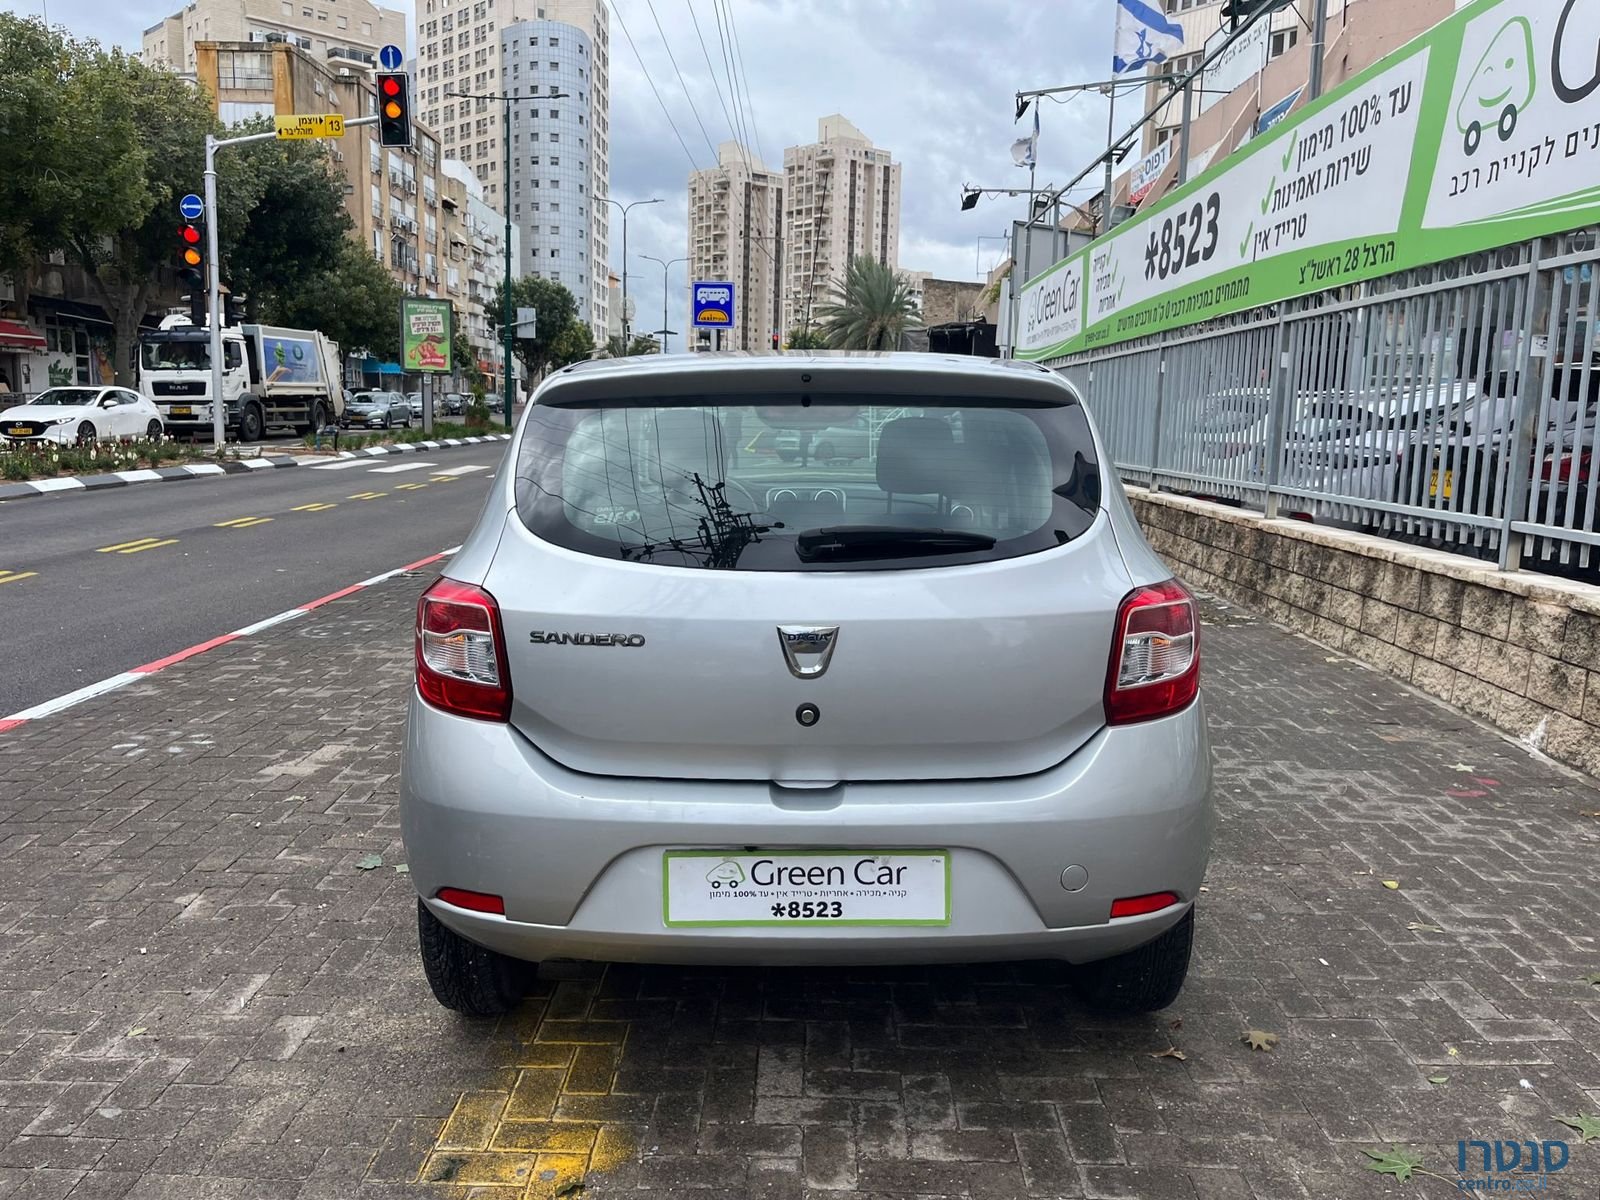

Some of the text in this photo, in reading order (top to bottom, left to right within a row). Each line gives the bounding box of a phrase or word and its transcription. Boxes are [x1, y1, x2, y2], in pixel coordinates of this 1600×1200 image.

[1389, 80, 1412, 117] עד
[284, 126, 313, 136] מוהליבר
[298, 116, 319, 126] ויצמן
[329, 120, 340, 131] 13
[1340, 94, 1381, 142] 100%
[1296, 123, 1333, 172] מימון
[1487, 135, 1555, 185] לקניית
[1145, 148, 1165, 175] דפוס
[1272, 144, 1372, 214] שירות ואמינות
[1449, 168, 1480, 197] רכב
[1252, 213, 1307, 262] טרייד אין
[1299, 240, 1395, 284] הרצל 28 ראשל"צ
[1037, 270, 1080, 324] Green Car
[1186, 288, 1214, 313] במכירת
[1216, 276, 1250, 303] מתמחים
[1172, 296, 1186, 317] רכבי
[529, 630, 646, 648] SANDERO
[788, 633, 828, 641] DACIA
[751, 859, 907, 886] Green Car
[709, 889, 907, 899] קניה מכירה אחריות טרייד אין עד 100% מימון
